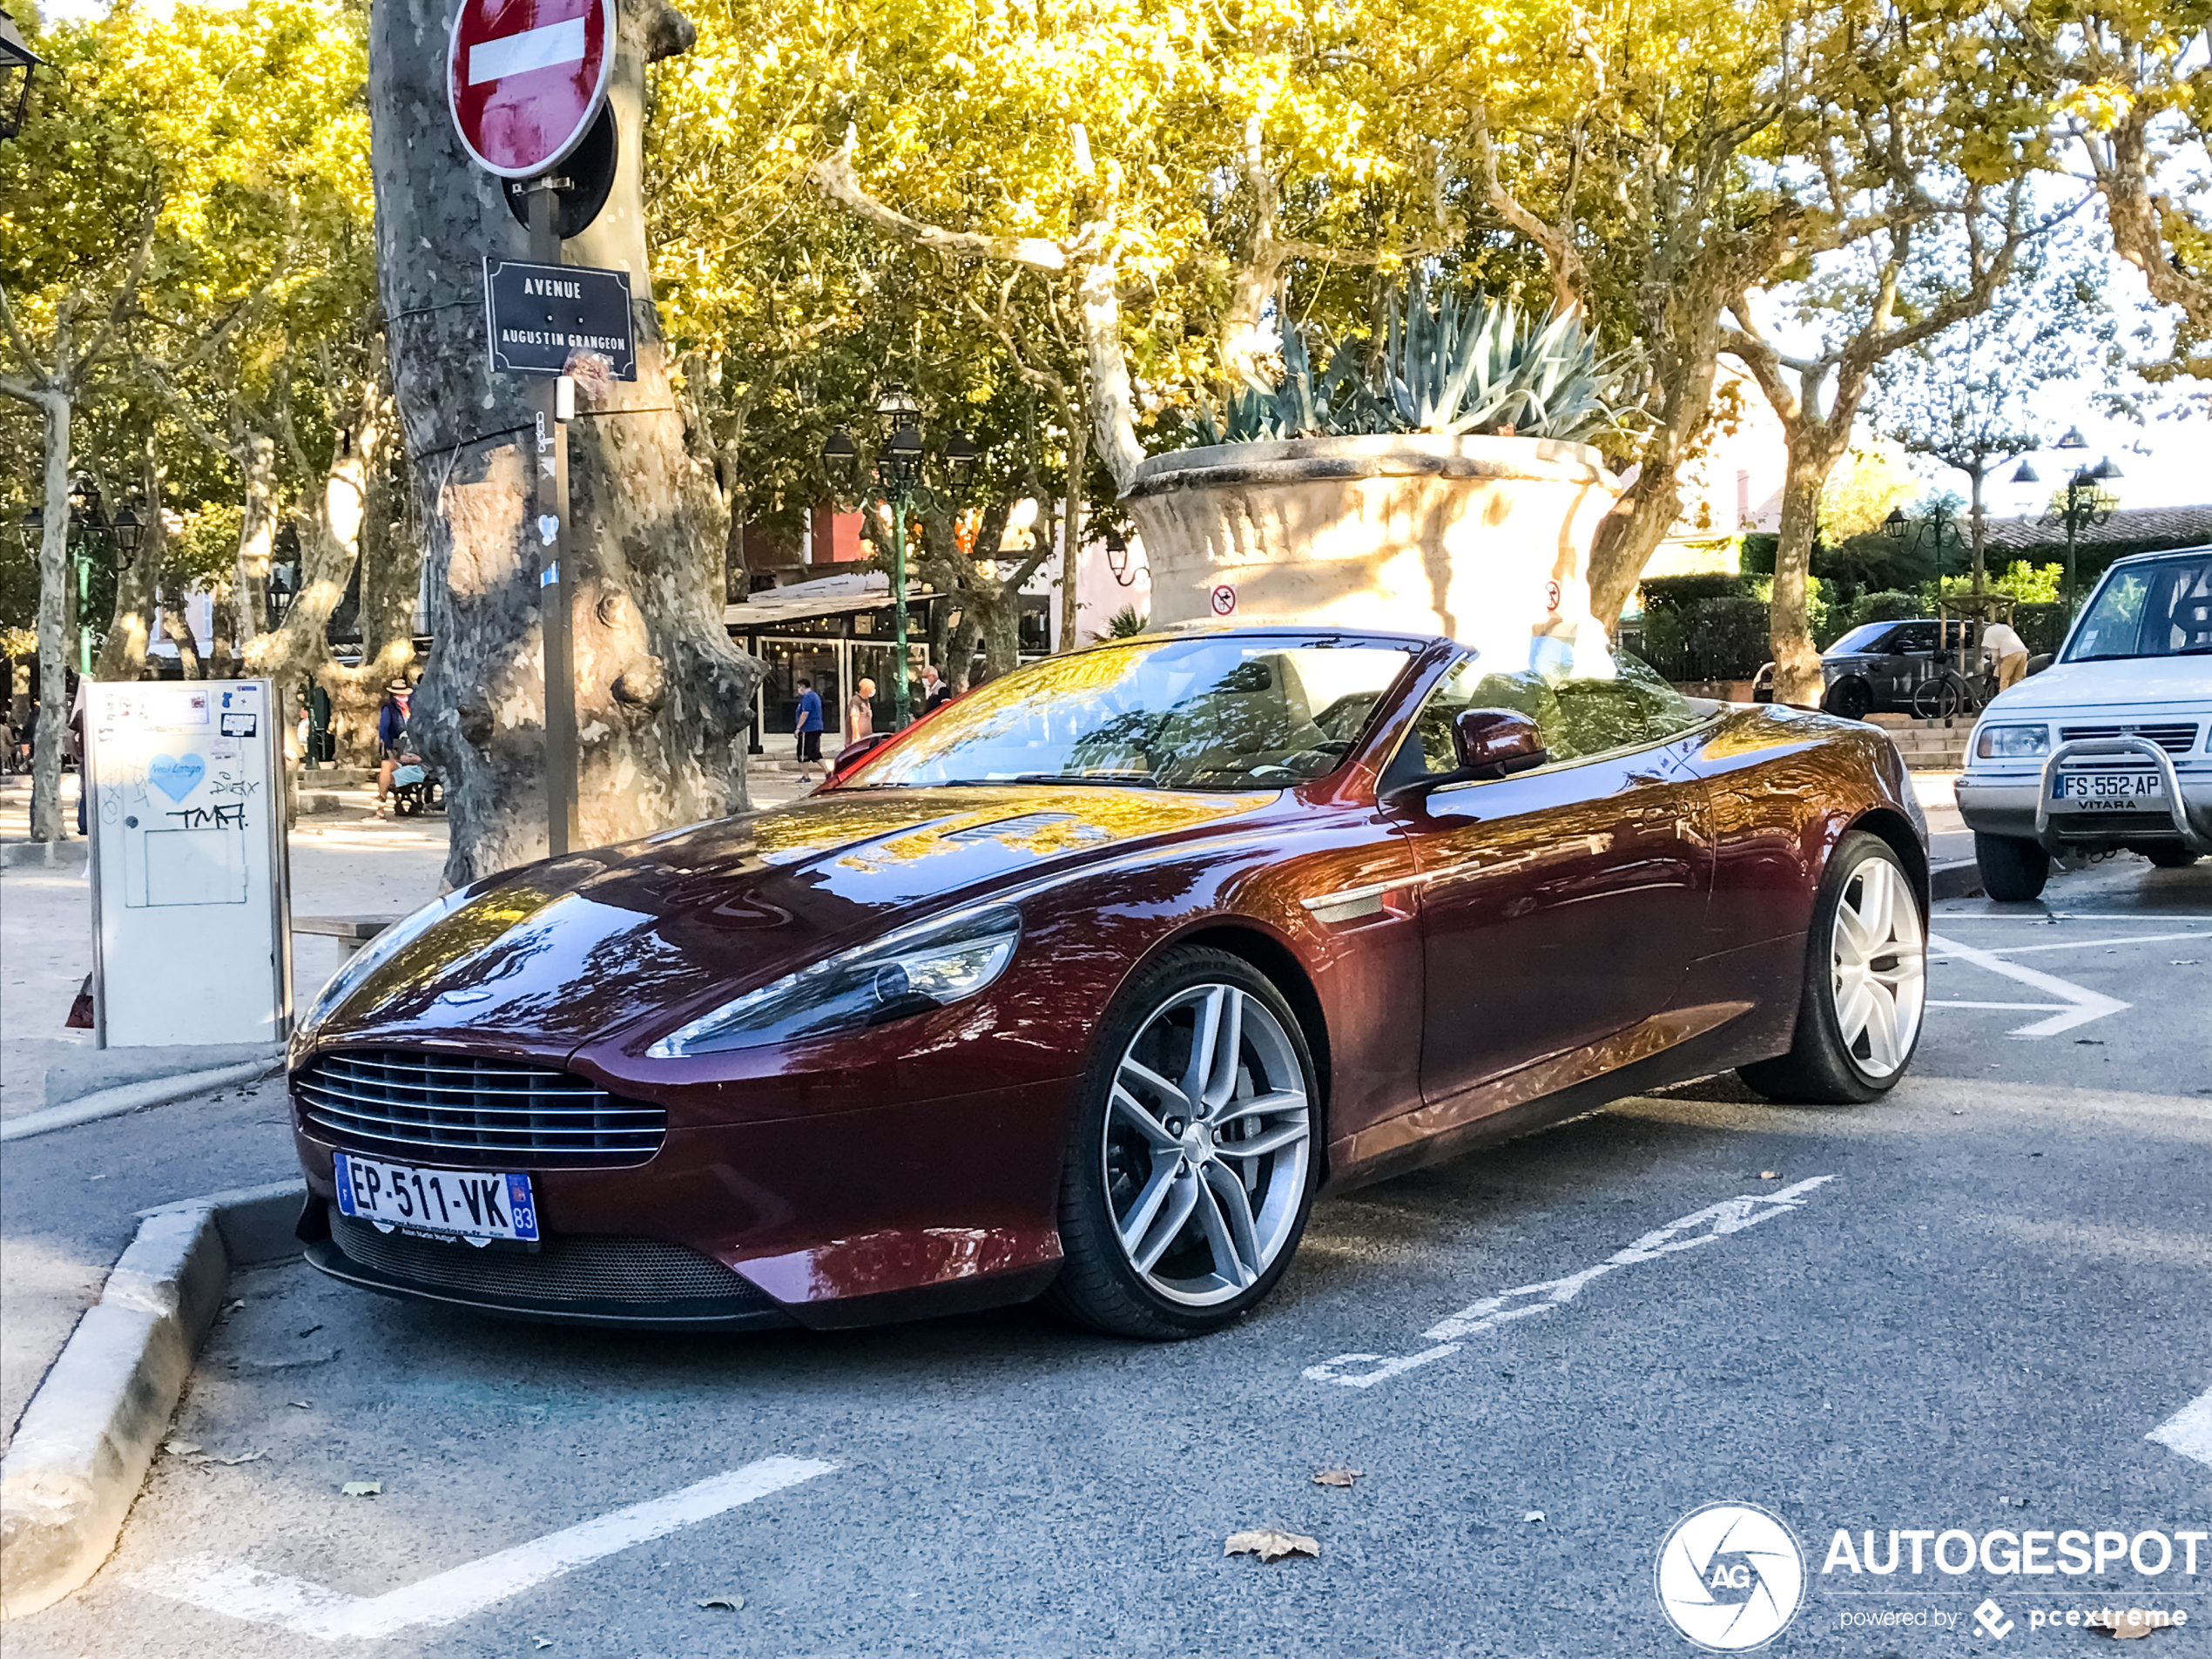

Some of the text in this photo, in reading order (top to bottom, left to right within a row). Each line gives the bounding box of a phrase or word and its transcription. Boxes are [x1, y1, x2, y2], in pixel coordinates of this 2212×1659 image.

[524, 278, 582, 299] AVENUE
[502, 329, 625, 350] AUGUSTIN GRANGEON
[2065, 776, 2159, 796] FS-552-AP
[2079, 800, 2137, 810] VITARA
[350, 1162, 509, 1228] EP-511-VK
[514, 1207, 534, 1229] 83
